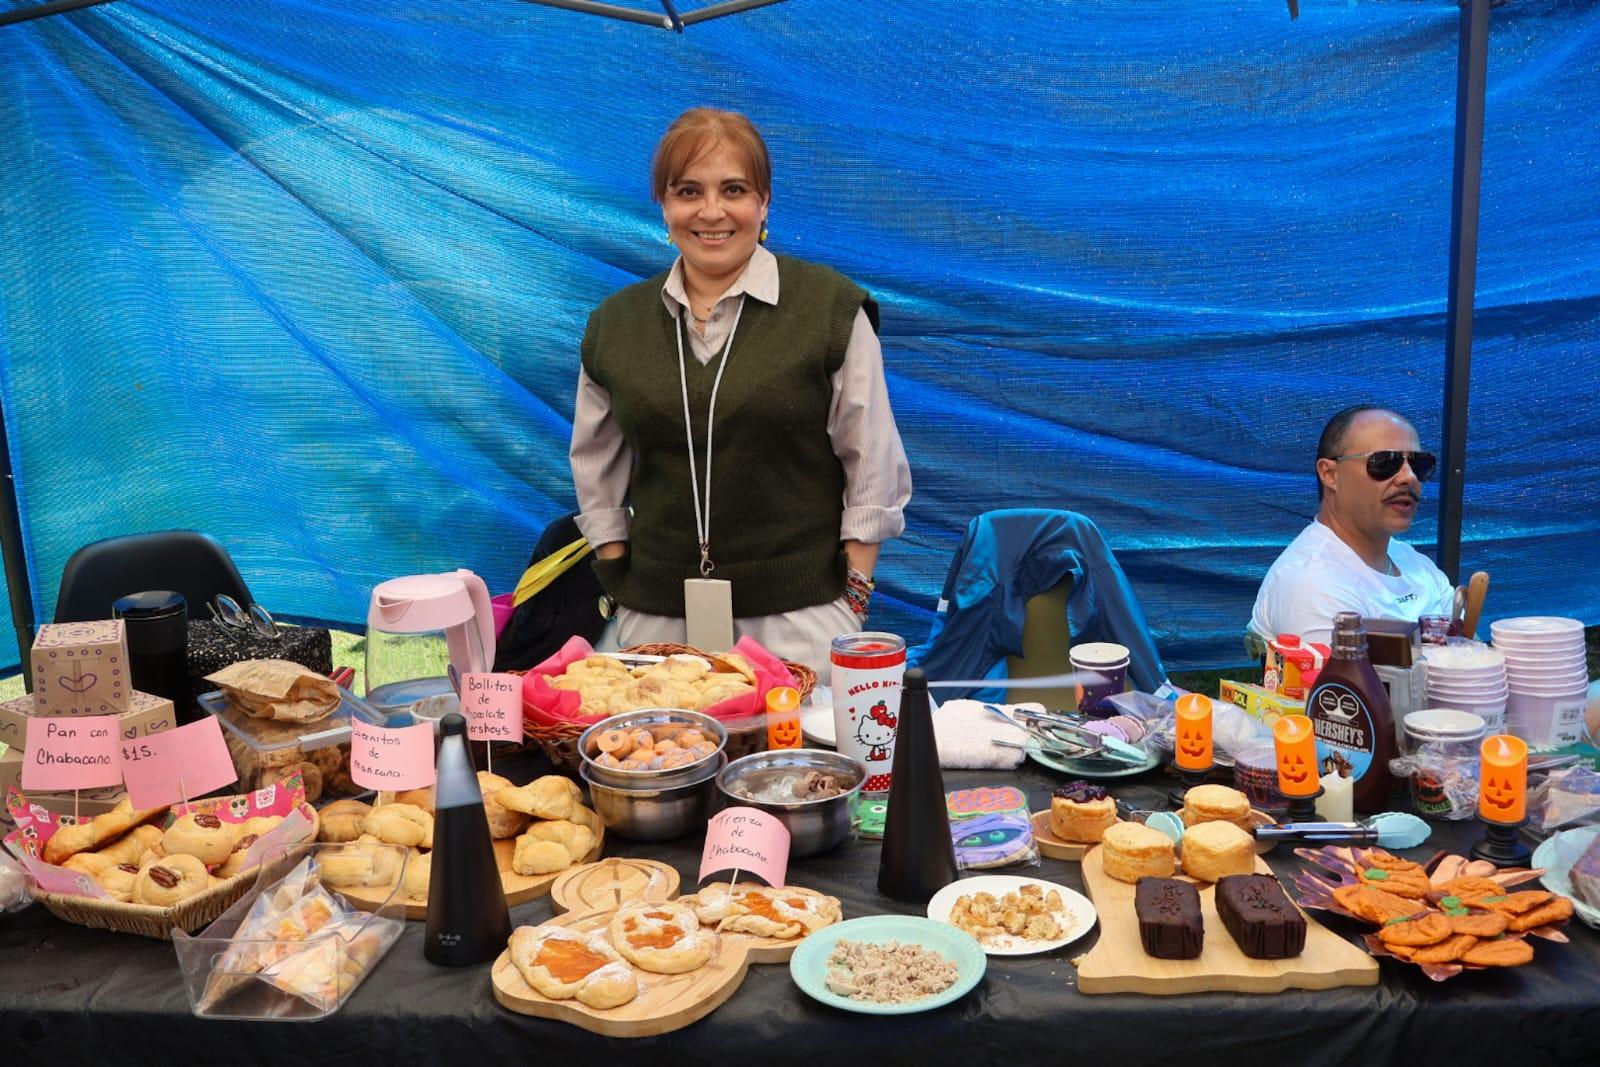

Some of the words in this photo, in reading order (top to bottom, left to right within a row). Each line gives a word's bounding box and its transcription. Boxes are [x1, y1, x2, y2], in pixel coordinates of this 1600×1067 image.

[468, 677, 513, 692] Bollitos
[848, 681, 879, 696] HELLO
[478, 693, 490, 704] de
[47, 723, 76, 737] Pan
[90, 729, 108, 737] con
[1315, 719, 1364, 746] HERSHEY'S
[36, 748, 111, 765] Chabacano
[121, 746, 157, 760] $15.
[368, 747, 380, 758] de
[715, 814, 762, 827] Trenza
[731, 826, 744, 837] de
